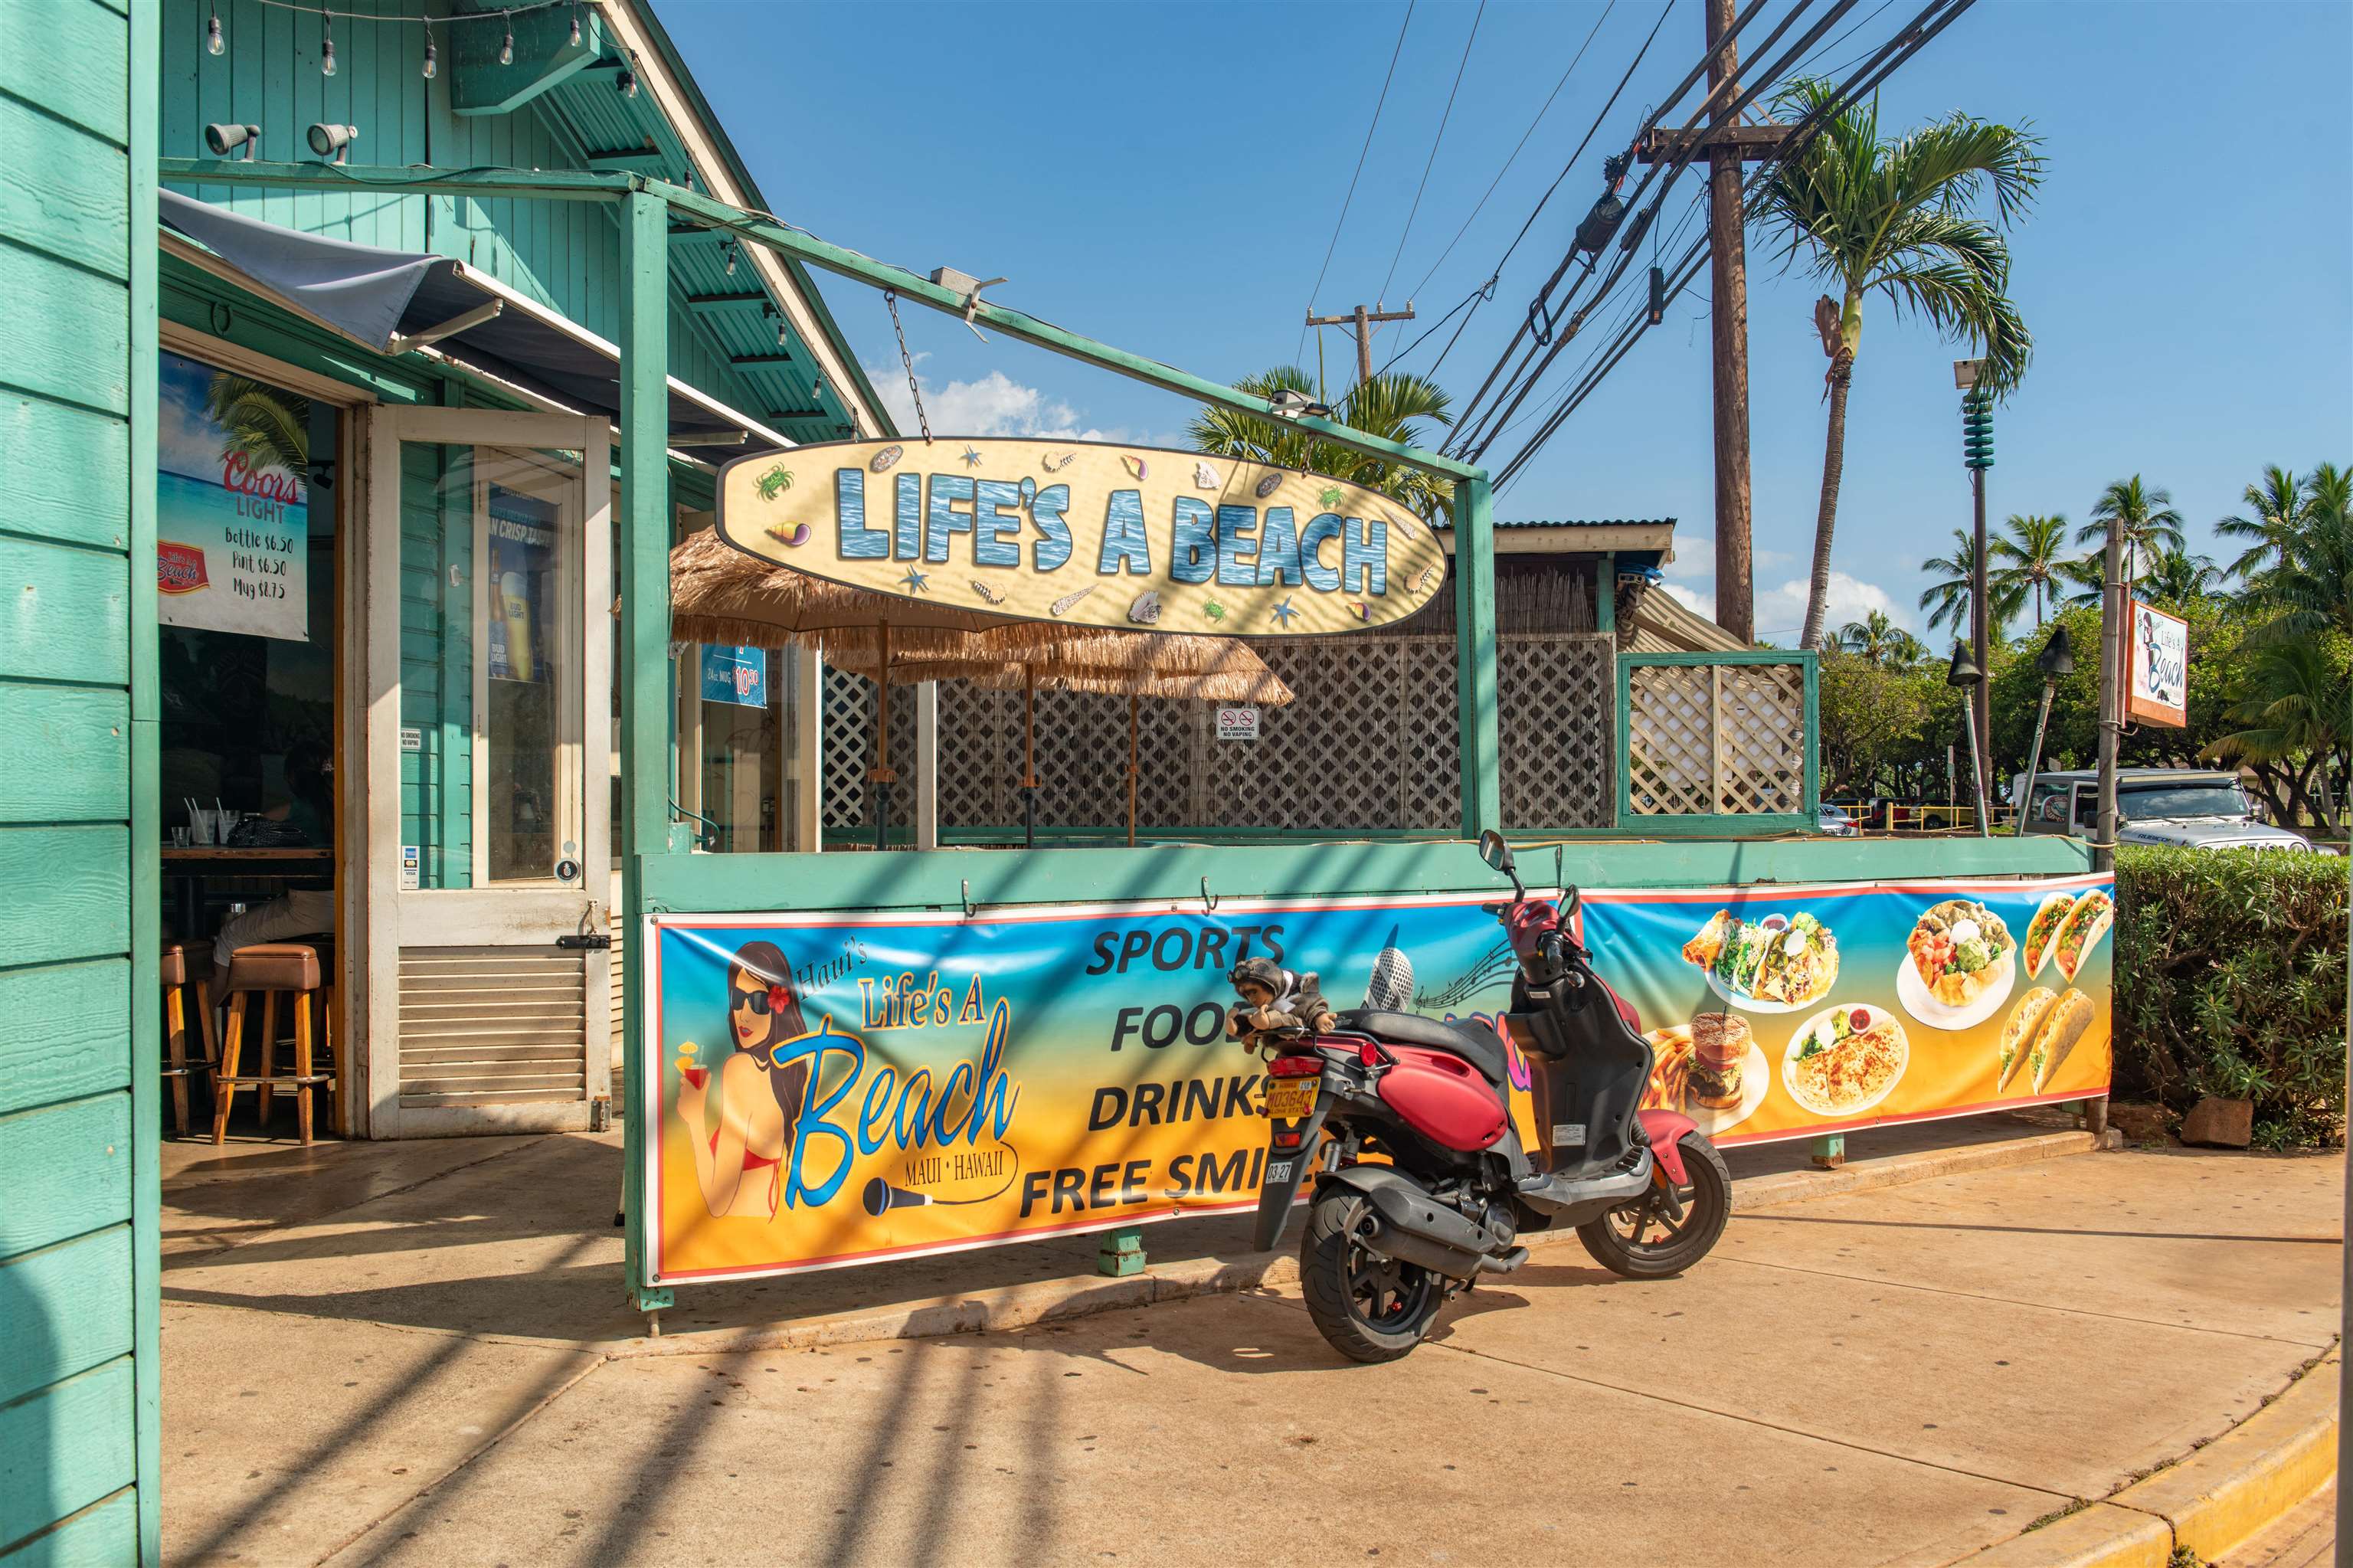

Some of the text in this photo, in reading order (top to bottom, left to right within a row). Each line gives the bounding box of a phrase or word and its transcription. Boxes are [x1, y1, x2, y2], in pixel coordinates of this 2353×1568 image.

[224, 450, 298, 505] Coors
[236, 496, 285, 524] LIGHT
[226, 527, 293, 554] Bottle $6.50
[499, 520, 527, 542] CRISP
[836, 466, 1388, 595] LIFE'S A BEACH
[233, 552, 286, 576] Pint $6.50
[234, 578, 285, 600] Mug $8.75
[509, 610, 525, 620] LIGHT
[510, 602, 522, 611] BUD
[492, 643, 505, 653] BUD
[2161, 630, 2175, 650] Life's
[490, 652, 508, 663] LIGHT
[2148, 642, 2184, 693] Beach
[720, 669, 731, 686] MUG
[1086, 925, 1284, 975] SPORTS
[795, 935, 869, 1002] Haui's
[858, 970, 987, 1032] Life's A
[770, 997, 1023, 1210] Beach
[905, 1151, 1003, 1187] MAUI HAWAII
[1268, 1164, 1291, 1180] 03 27
[1019, 1159, 1152, 1218] FREE
